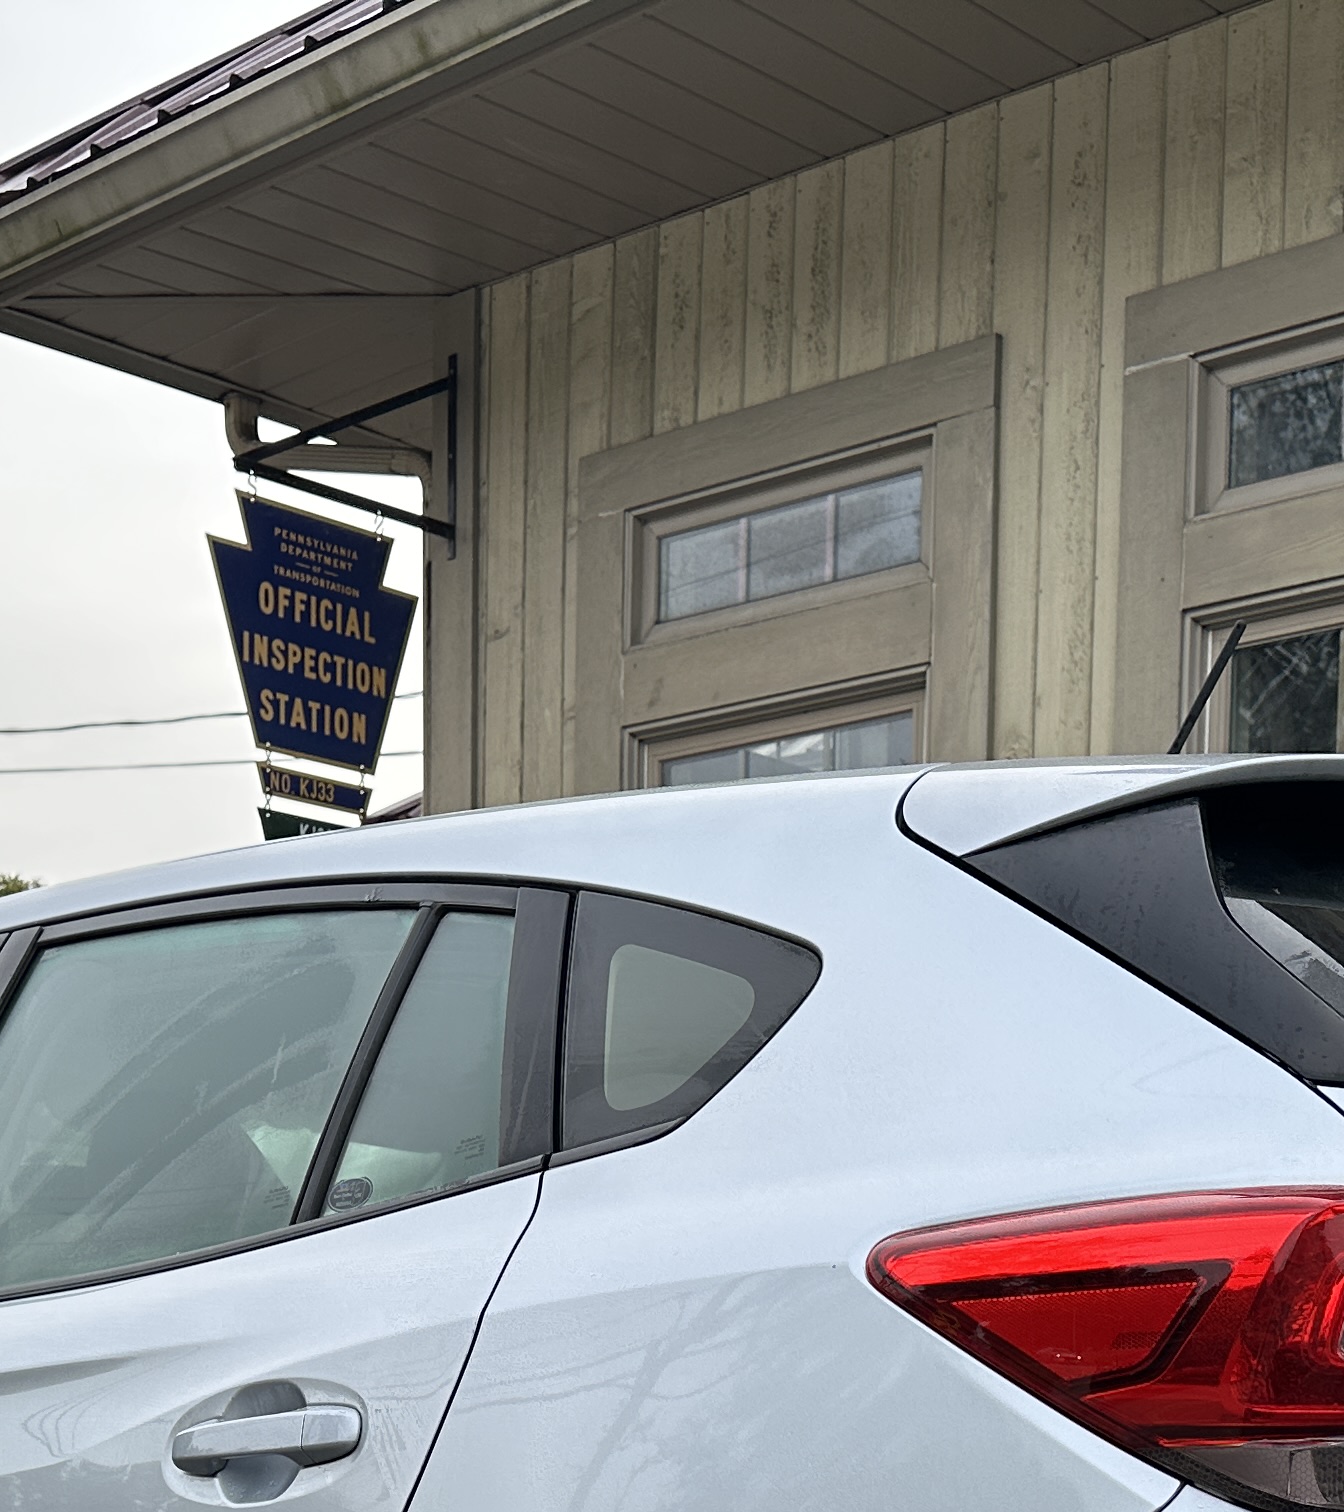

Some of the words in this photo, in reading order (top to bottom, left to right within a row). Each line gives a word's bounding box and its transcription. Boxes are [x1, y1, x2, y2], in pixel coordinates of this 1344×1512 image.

[273, 526, 359, 561] PENNSYLVANIA
[279, 542, 354, 572] DEPARTMENT
[272, 564, 360, 599] TRANSPORTATION
[258, 581, 376, 645] OFFICIAL
[242, 630, 387, 699] INSPECTION
[259, 688, 367, 745] STATION
[270, 771, 296, 795] NO.
[299, 777, 335, 803] KJ33
